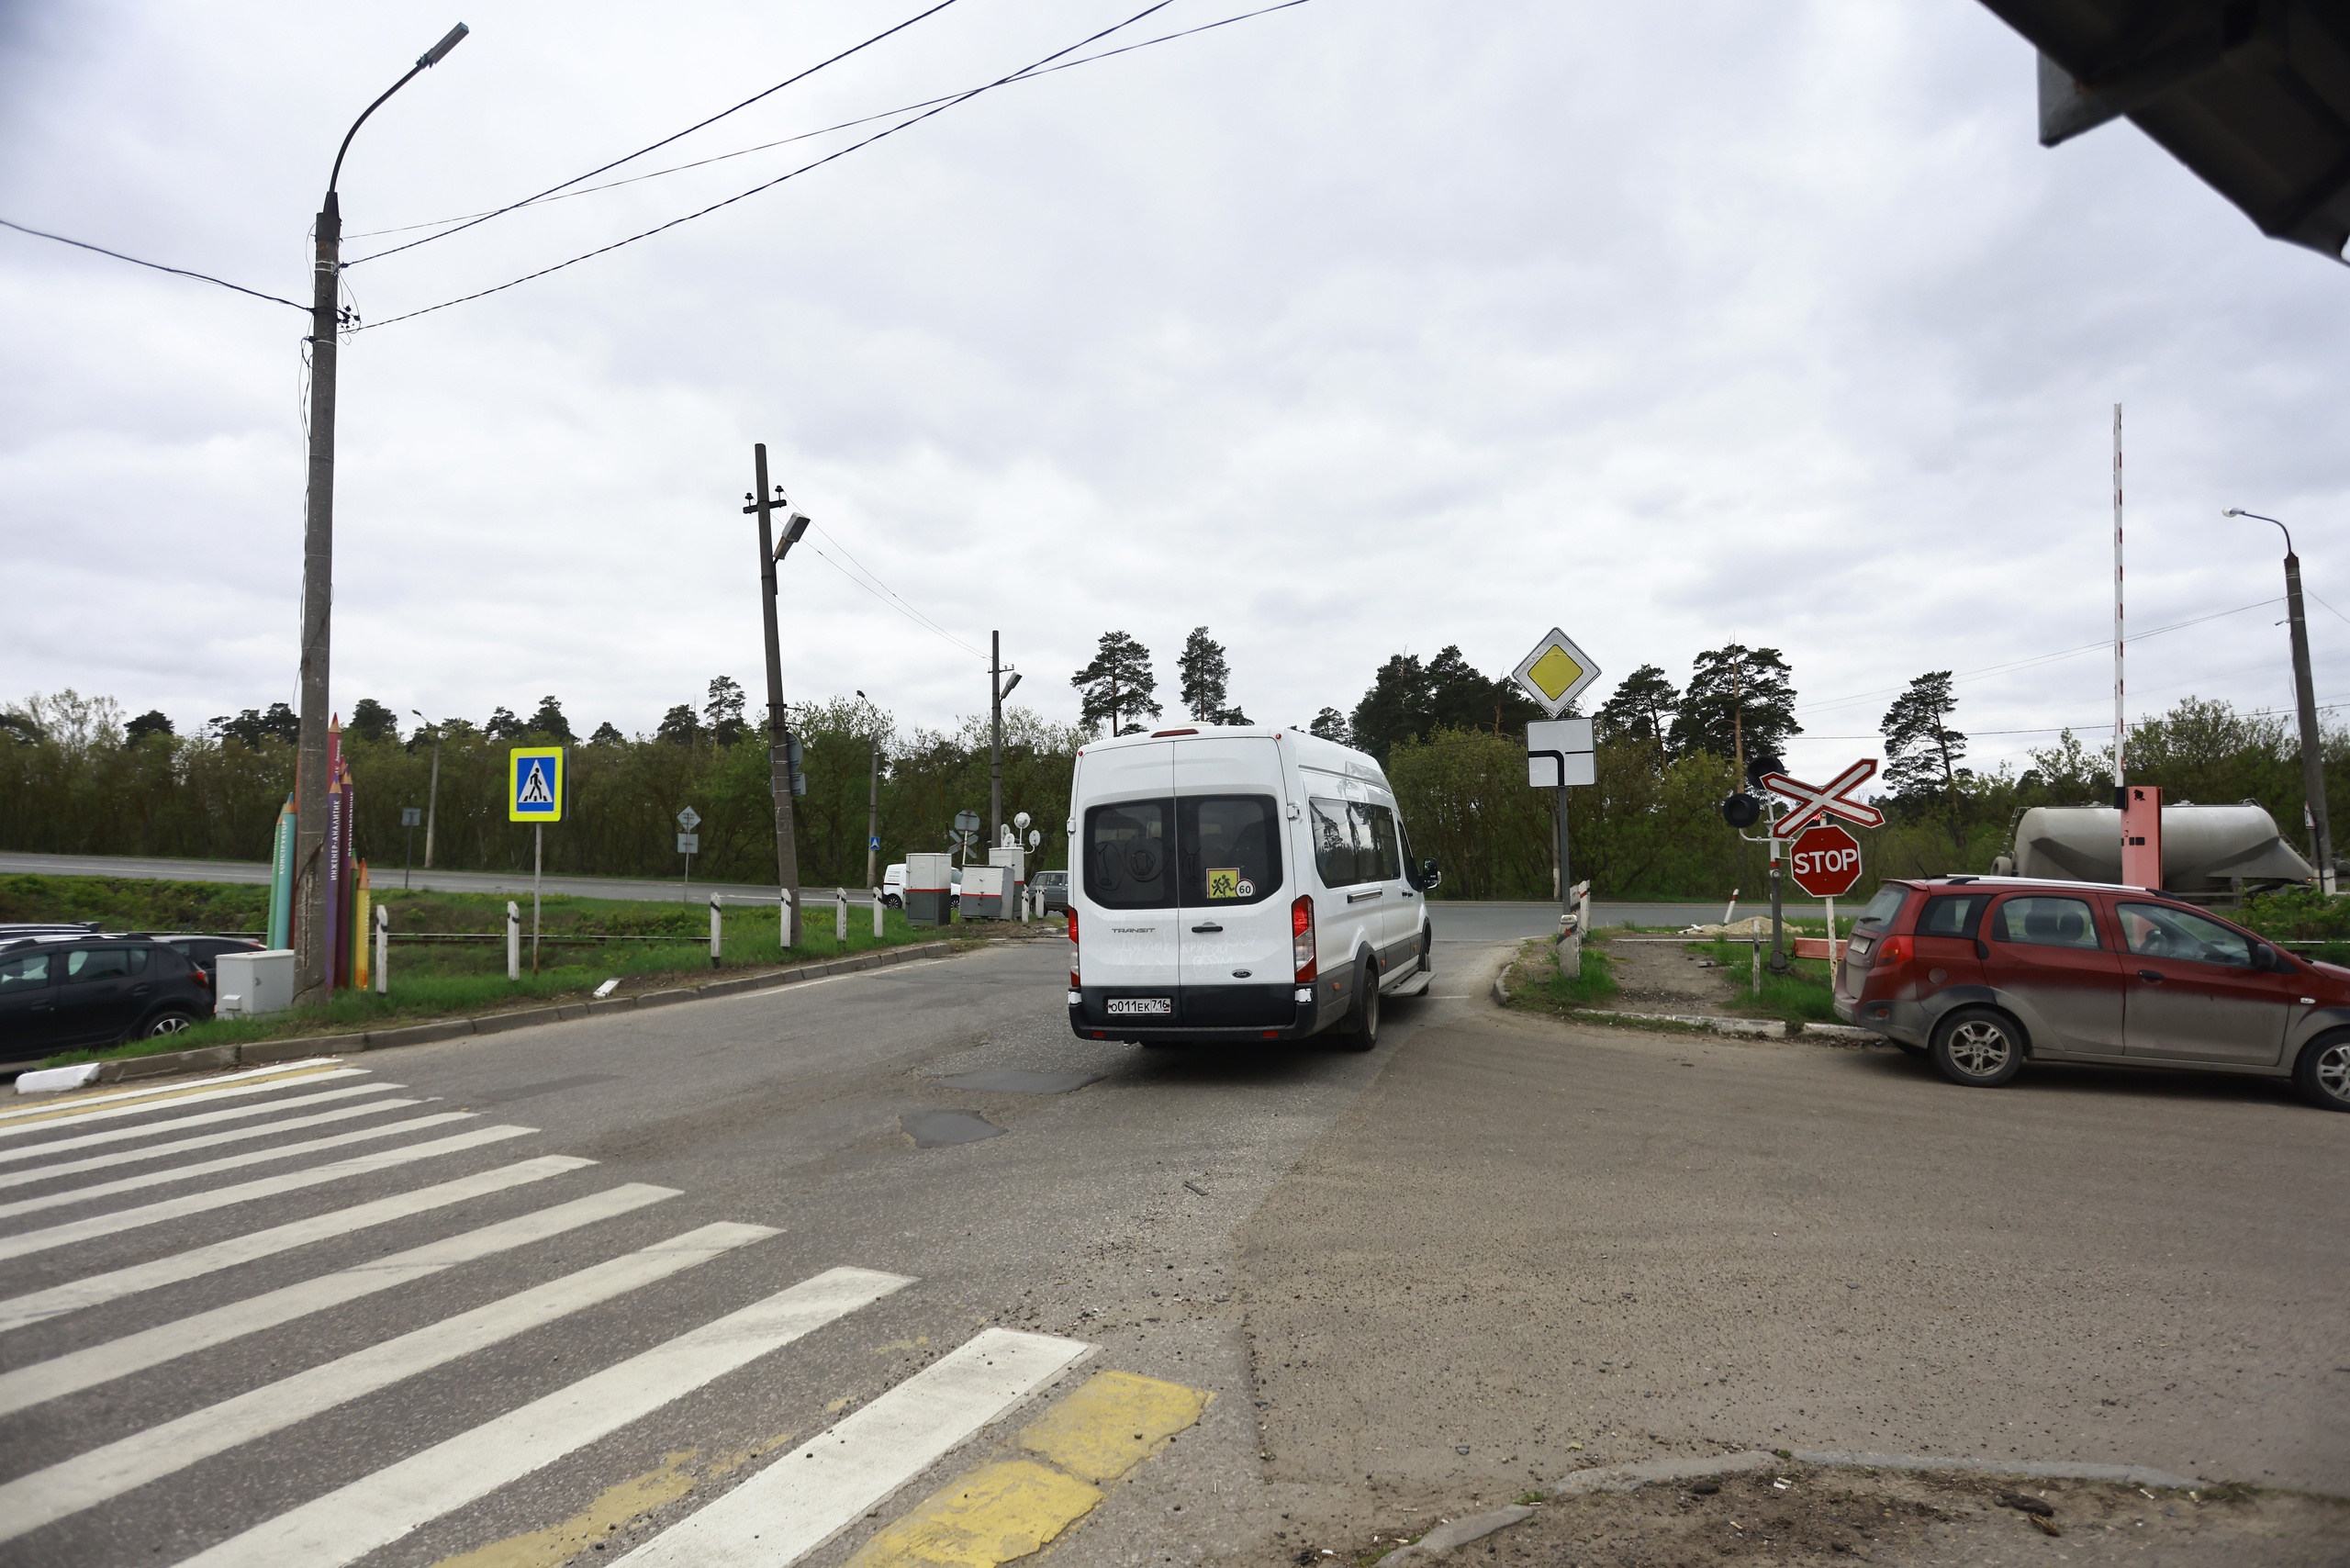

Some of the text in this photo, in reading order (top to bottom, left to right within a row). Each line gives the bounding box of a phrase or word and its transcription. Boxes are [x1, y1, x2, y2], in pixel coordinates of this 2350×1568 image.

[278, 820, 287, 875] КОНСТРУКТОР
[330, 800, 341, 881] ИНЖЕНЕР-АНАЛИТИК
[1794, 848, 1858, 874] STOP
[1239, 885, 1251, 894] 60
